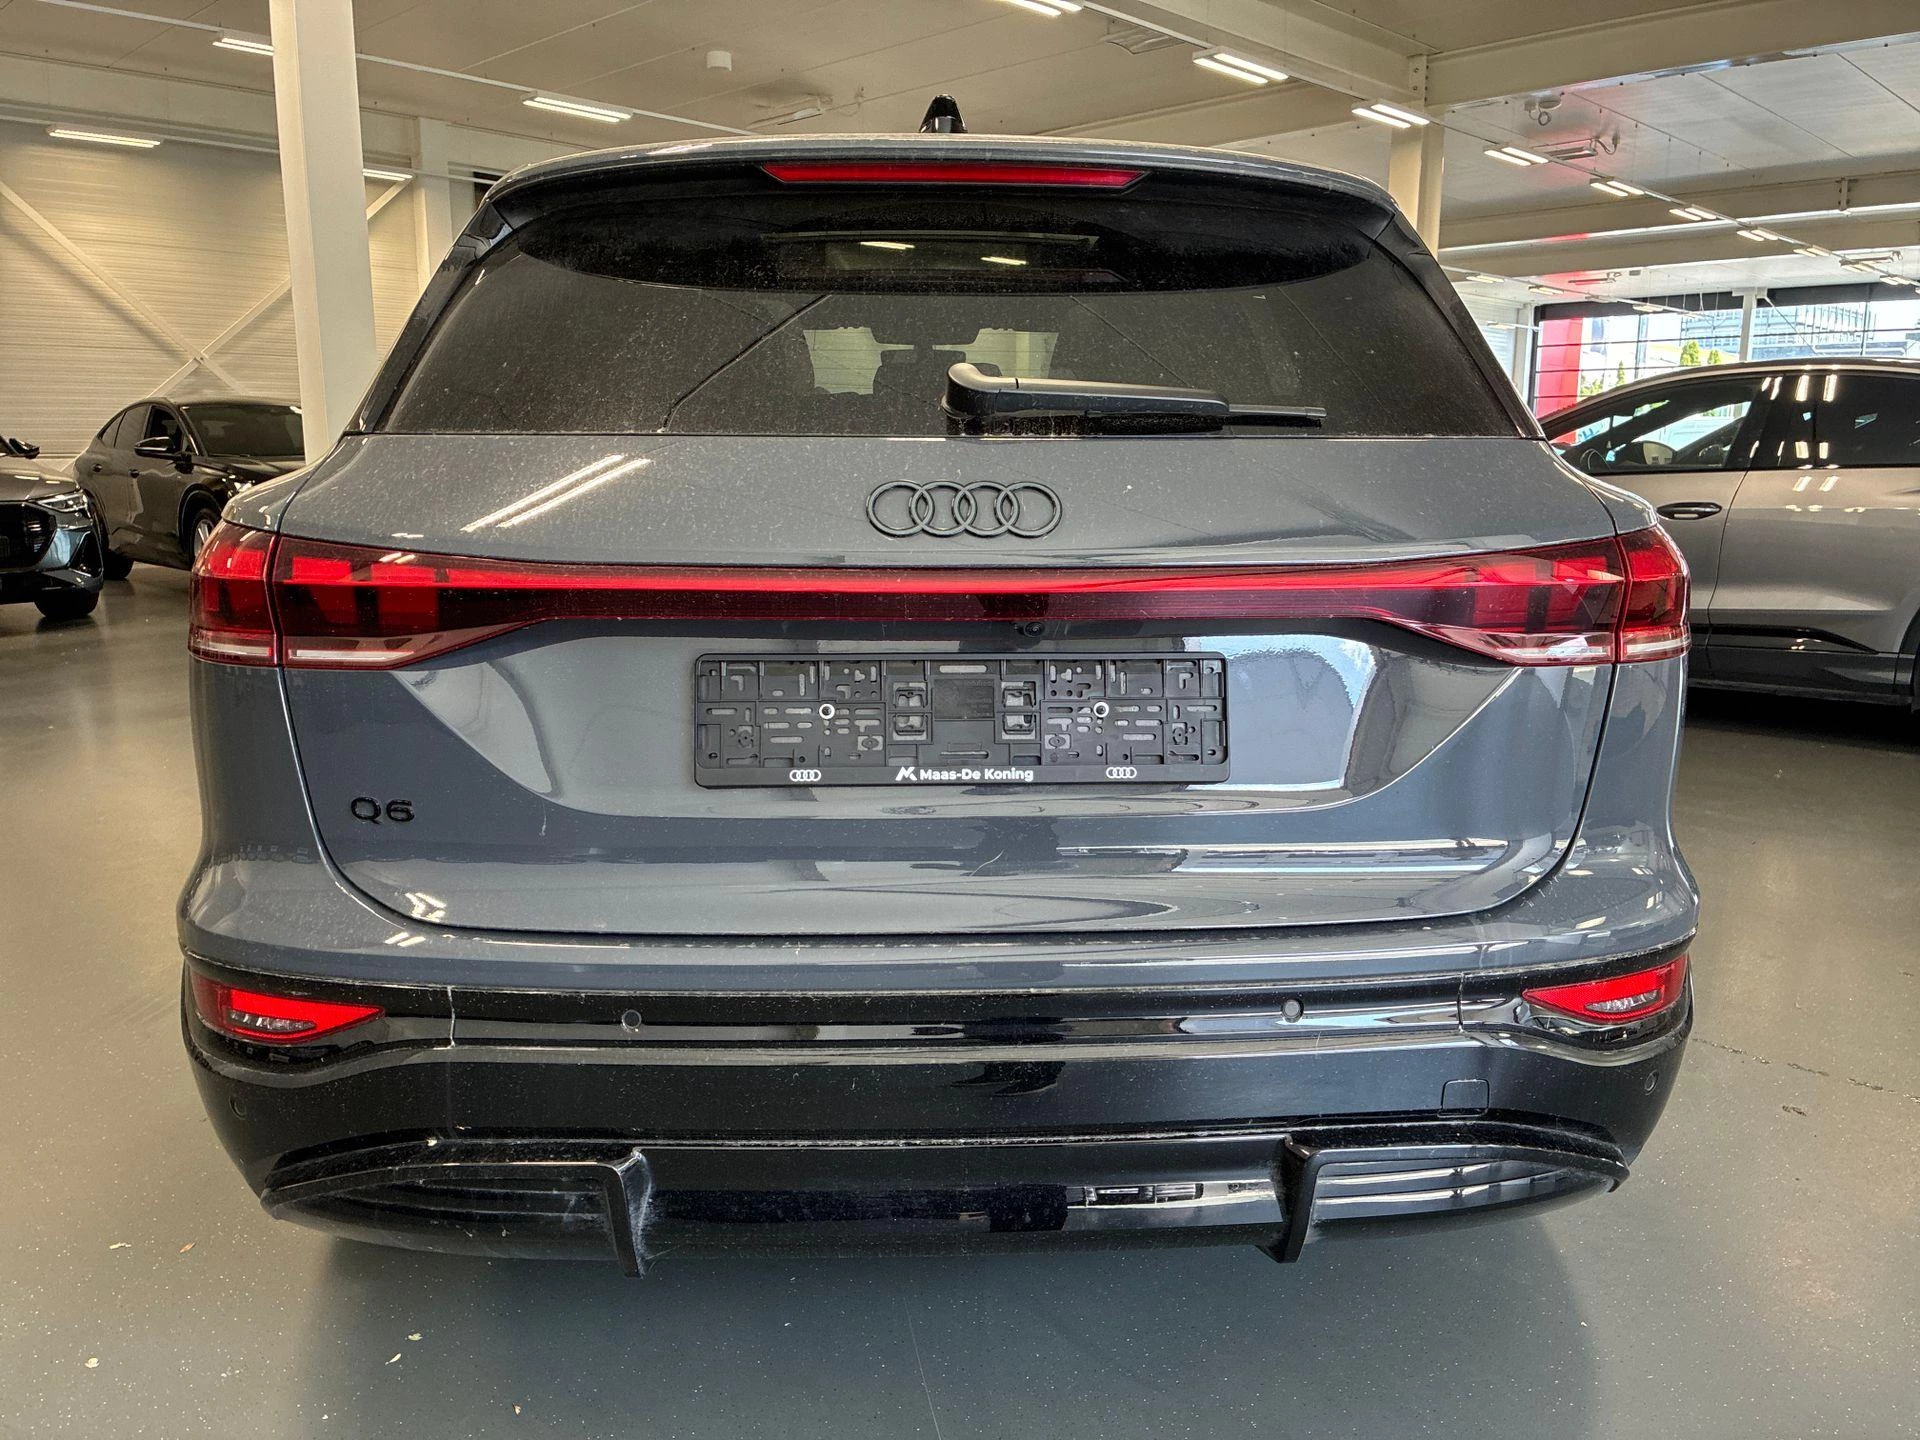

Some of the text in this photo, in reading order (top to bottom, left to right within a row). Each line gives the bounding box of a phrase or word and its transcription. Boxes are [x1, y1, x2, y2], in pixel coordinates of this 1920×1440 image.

[919, 768, 982, 781] Maas-De
[984, 766, 1034, 782] Koning
[350, 796, 415, 825] Q6
